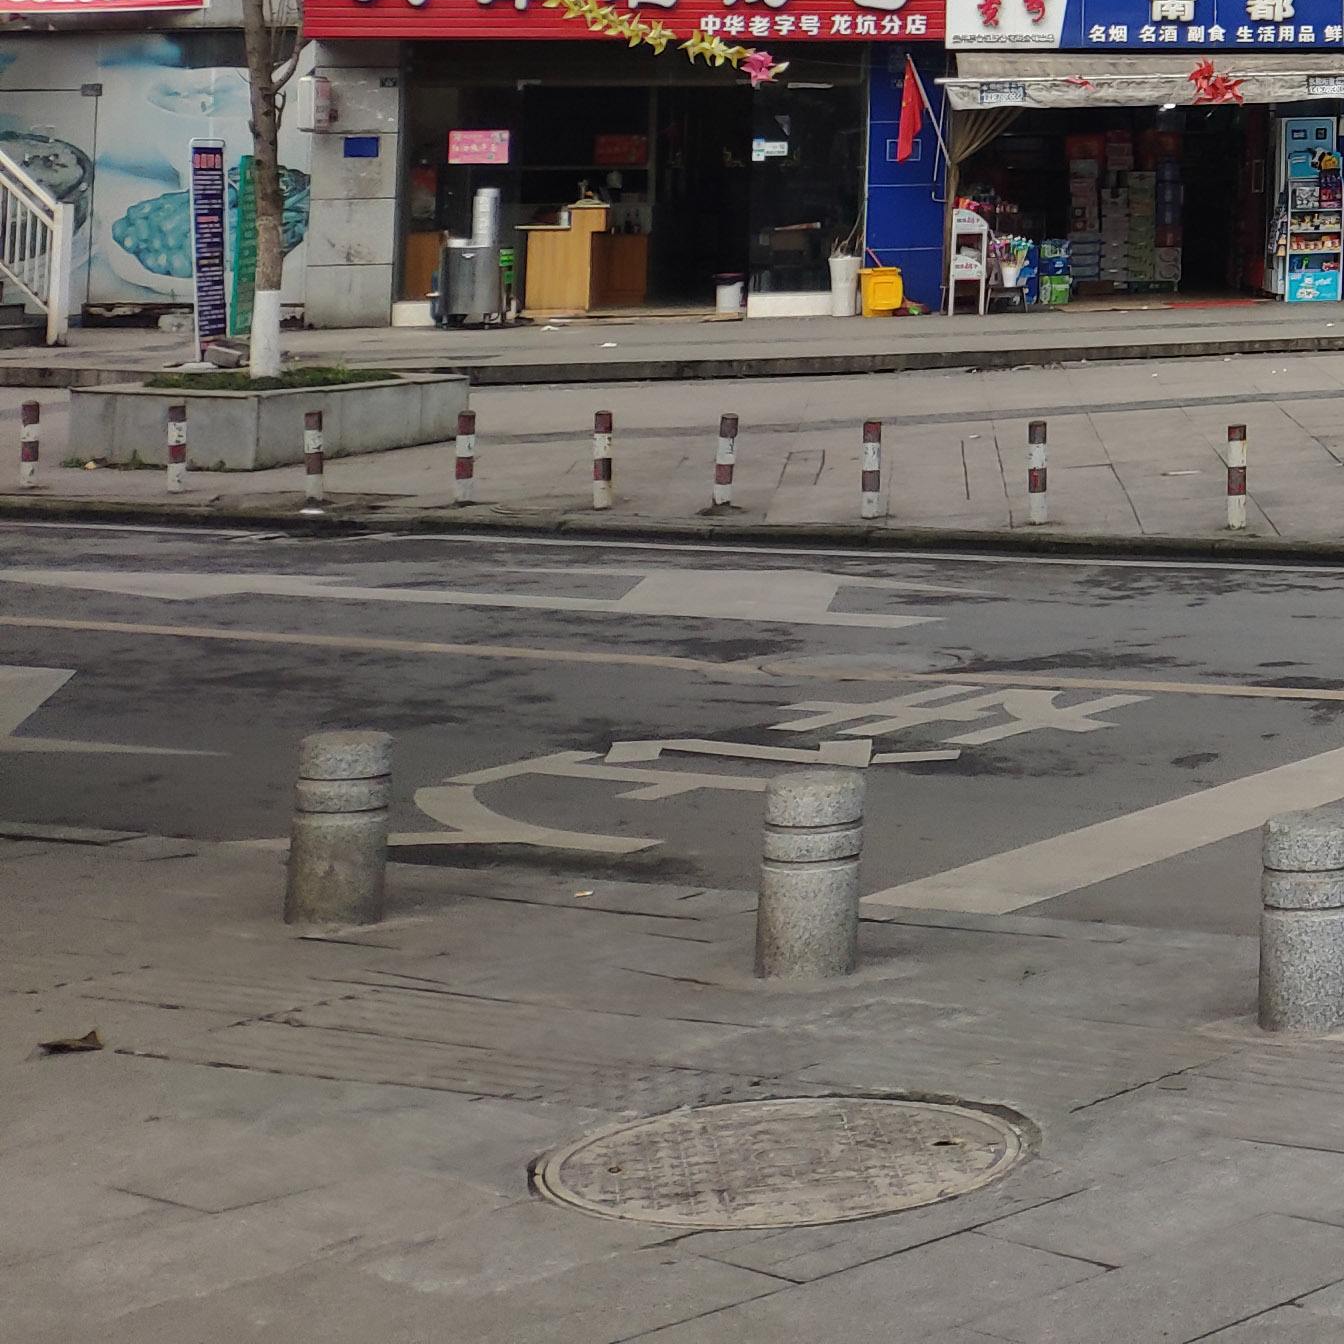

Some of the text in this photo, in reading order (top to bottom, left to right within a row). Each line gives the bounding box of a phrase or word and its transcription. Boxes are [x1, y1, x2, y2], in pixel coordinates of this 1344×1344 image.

[700, 13, 928, 36] 中华老字号 龙坑分店
[1088, 25, 1128, 44] 名烟
[1138, 25, 1178, 43] 名酒
[1187, 25, 1226, 44] 副食
[1236, 25, 1316, 44] 生活用品
